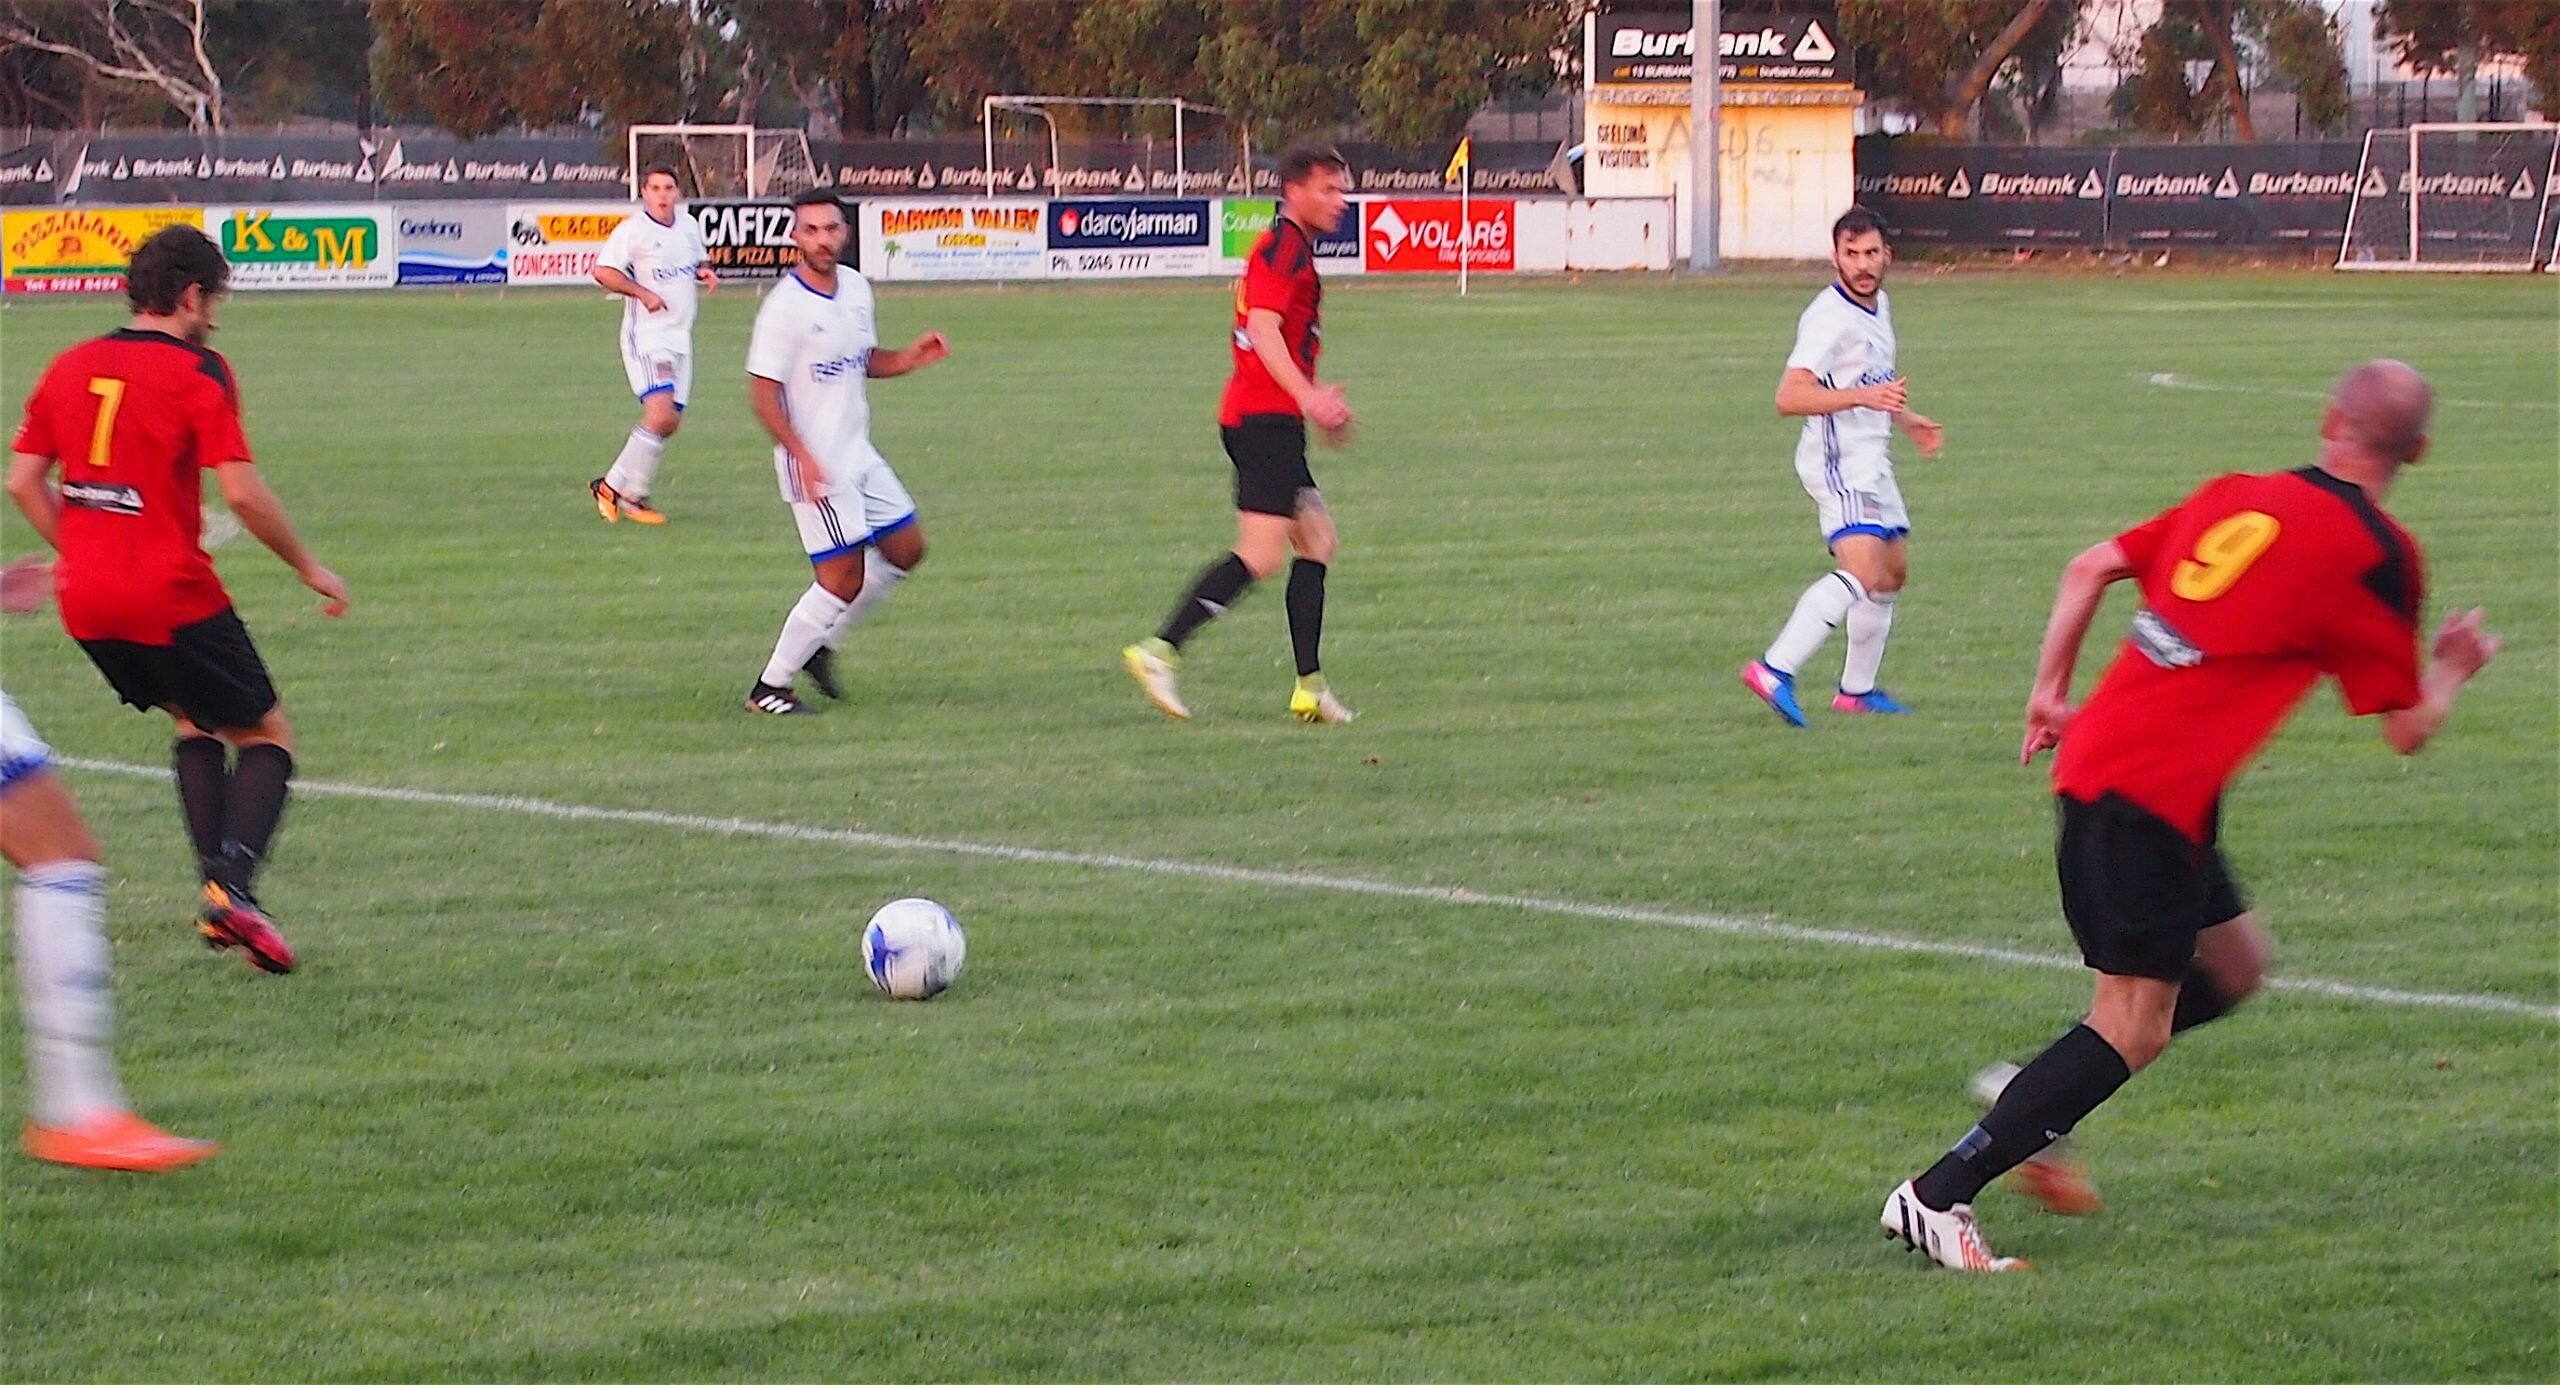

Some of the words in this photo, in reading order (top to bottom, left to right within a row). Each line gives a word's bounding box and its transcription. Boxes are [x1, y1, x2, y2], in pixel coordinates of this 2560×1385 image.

[133, 157, 195, 178] Burbank
[464, 161, 529, 181] Burbank
[553, 161, 620, 182] Burbank
[840, 165, 915, 186] Burbank
[1361, 169, 1440, 189] Burbank
[1980, 172, 2077, 196] Burbank
[2116, 173, 2213, 197] Burbank
[2249, 172, 2355, 195] Burbank
[400, 217, 463, 240] Geelong
[882, 207, 964, 236] BARWON
[972, 208, 1040, 236] VALLEY
[1081, 207, 1198, 241] darcyjarman
[232, 209, 276, 253] K
[281, 226, 309, 252] &
[313, 227, 368, 271] M
[1313, 239, 1359, 258] Lawyers
[514, 254, 578, 277] CONCRETE
[737, 247, 774, 265] PIZZA
[1120, 253, 1150, 270] 7777
[2169, 509, 2282, 602] 9
